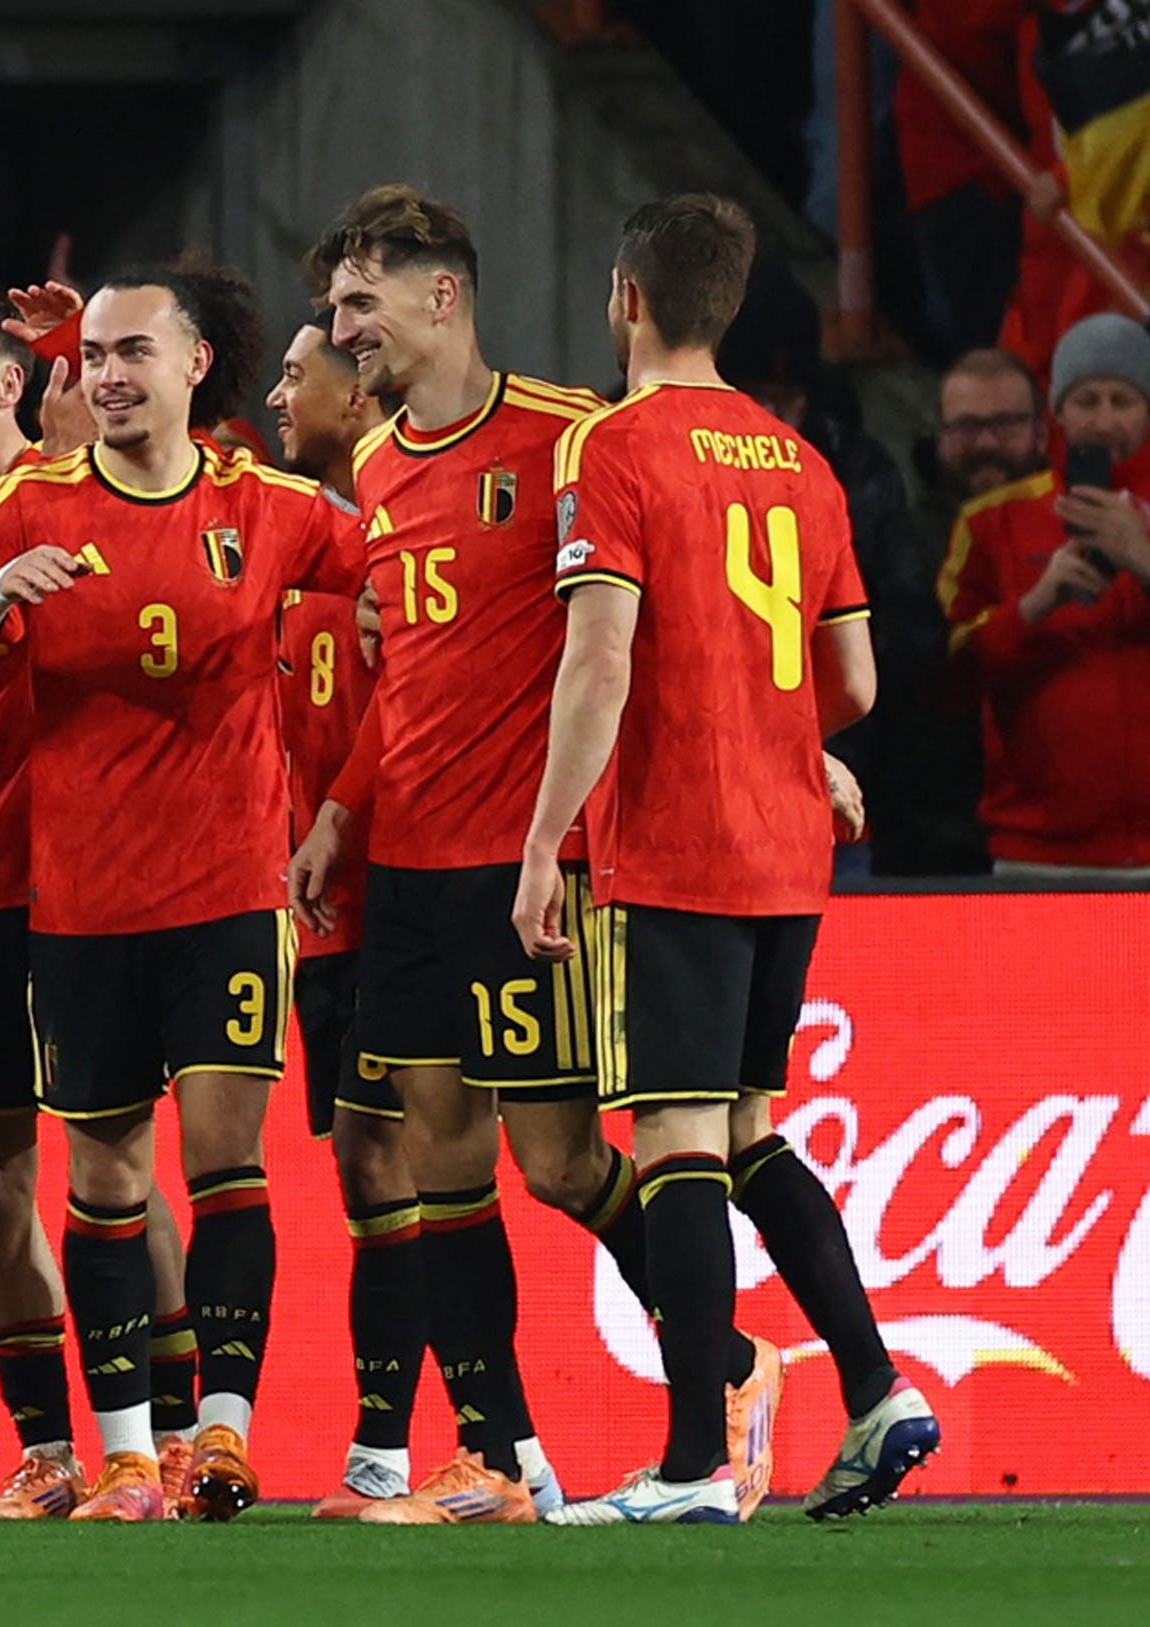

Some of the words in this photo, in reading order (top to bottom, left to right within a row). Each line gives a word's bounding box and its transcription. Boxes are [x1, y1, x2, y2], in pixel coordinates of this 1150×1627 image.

[689, 427, 802, 473] MECHELE
[399, 546, 458, 625] 15
[724, 502, 803, 692] 4
[138, 603, 179, 678] 3
[310, 631, 336, 707] 8
[226, 971, 266, 1047] 3
[470, 978, 541, 1057] 15
[88, 1313, 149, 1340] RBFA
[200, 1305, 262, 1322] RBFA
